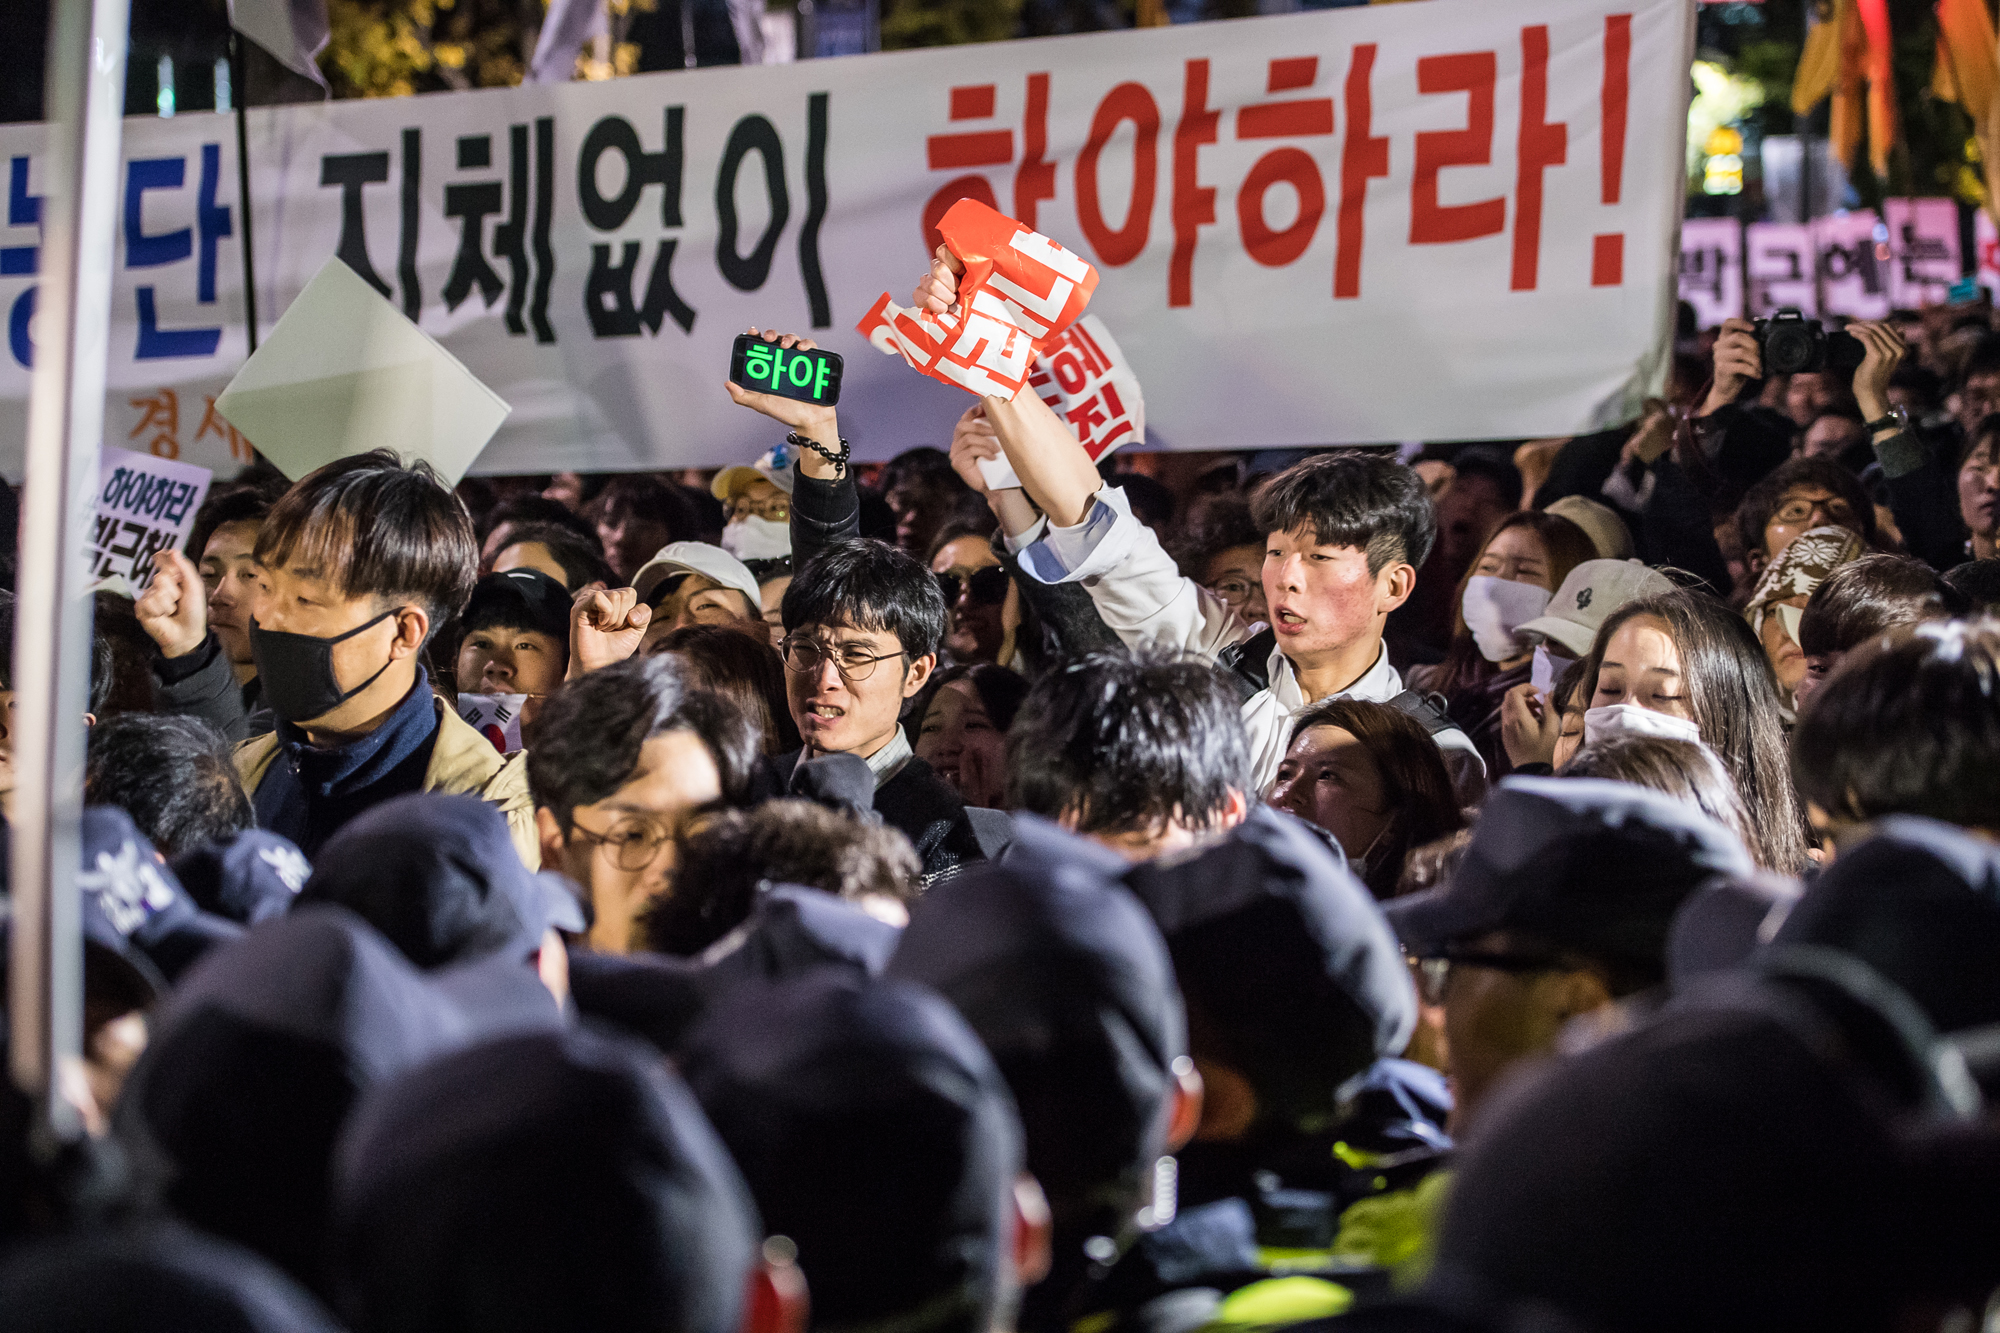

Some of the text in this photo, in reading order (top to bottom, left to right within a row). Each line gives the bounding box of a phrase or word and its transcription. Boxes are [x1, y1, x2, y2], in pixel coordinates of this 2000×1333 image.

[319, 92, 832, 342] 지체없이
[921, 13, 1632, 308] 하야하라!
[745, 344, 831, 400] 하야
[103, 466, 199, 528] 하야하라
